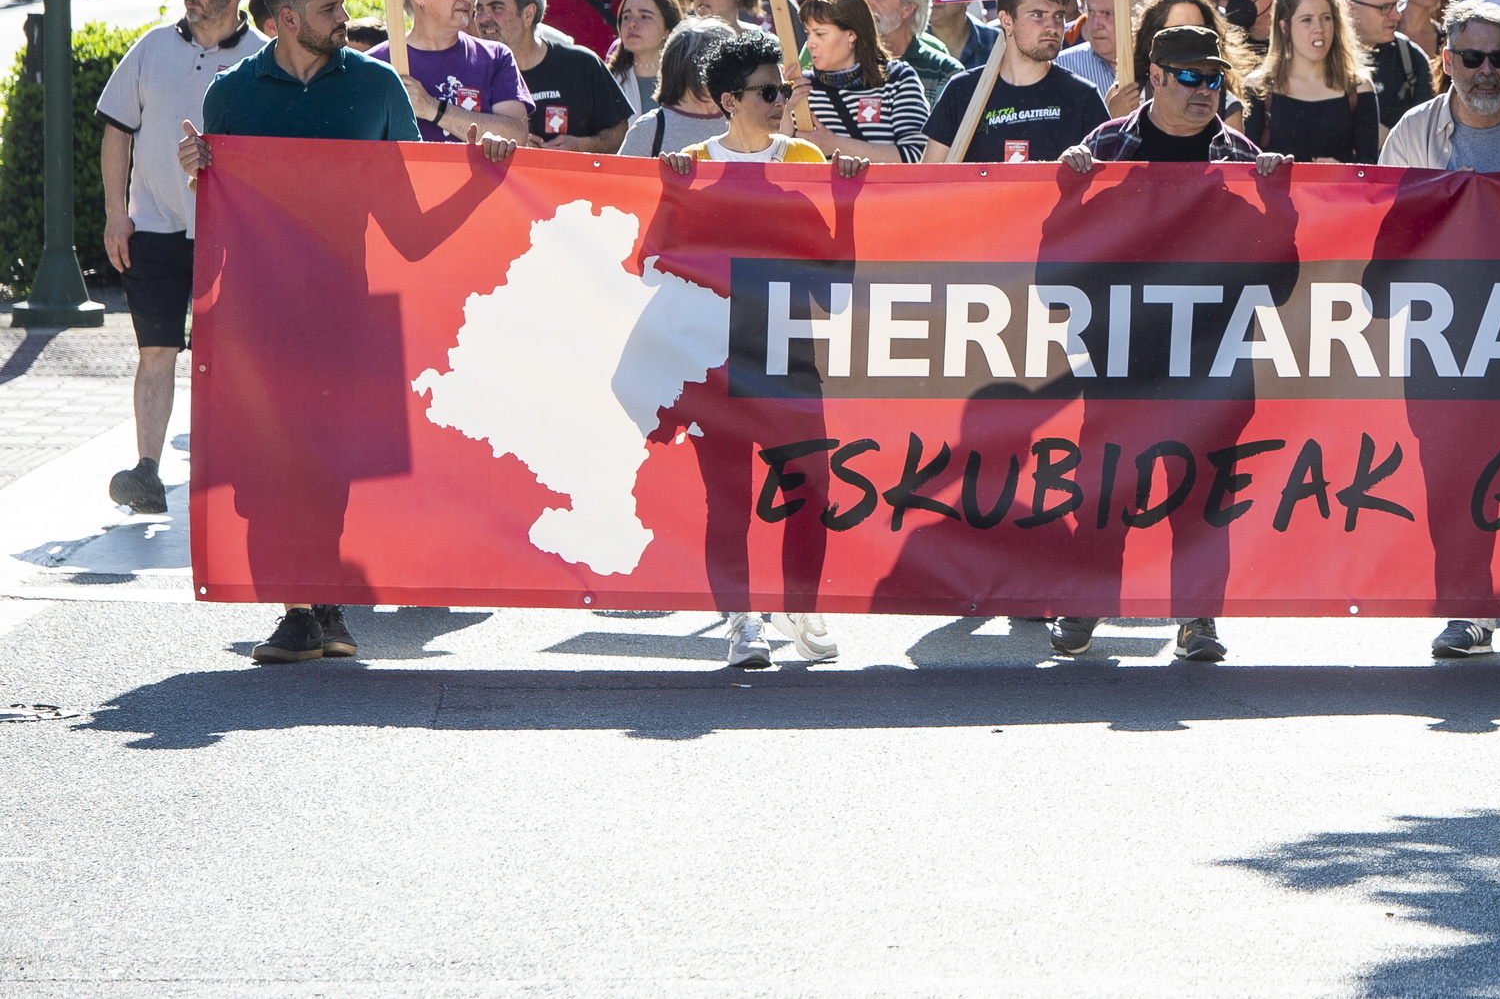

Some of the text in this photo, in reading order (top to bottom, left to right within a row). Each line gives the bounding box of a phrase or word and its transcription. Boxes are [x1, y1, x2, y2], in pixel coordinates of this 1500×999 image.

[985, 106, 1016, 120] ALTXA
[988, 112, 1018, 126] NAPAR
[1018, 108, 1061, 119] GAZTERIA!
[756, 431, 1414, 532] ESKUBIDEAK
